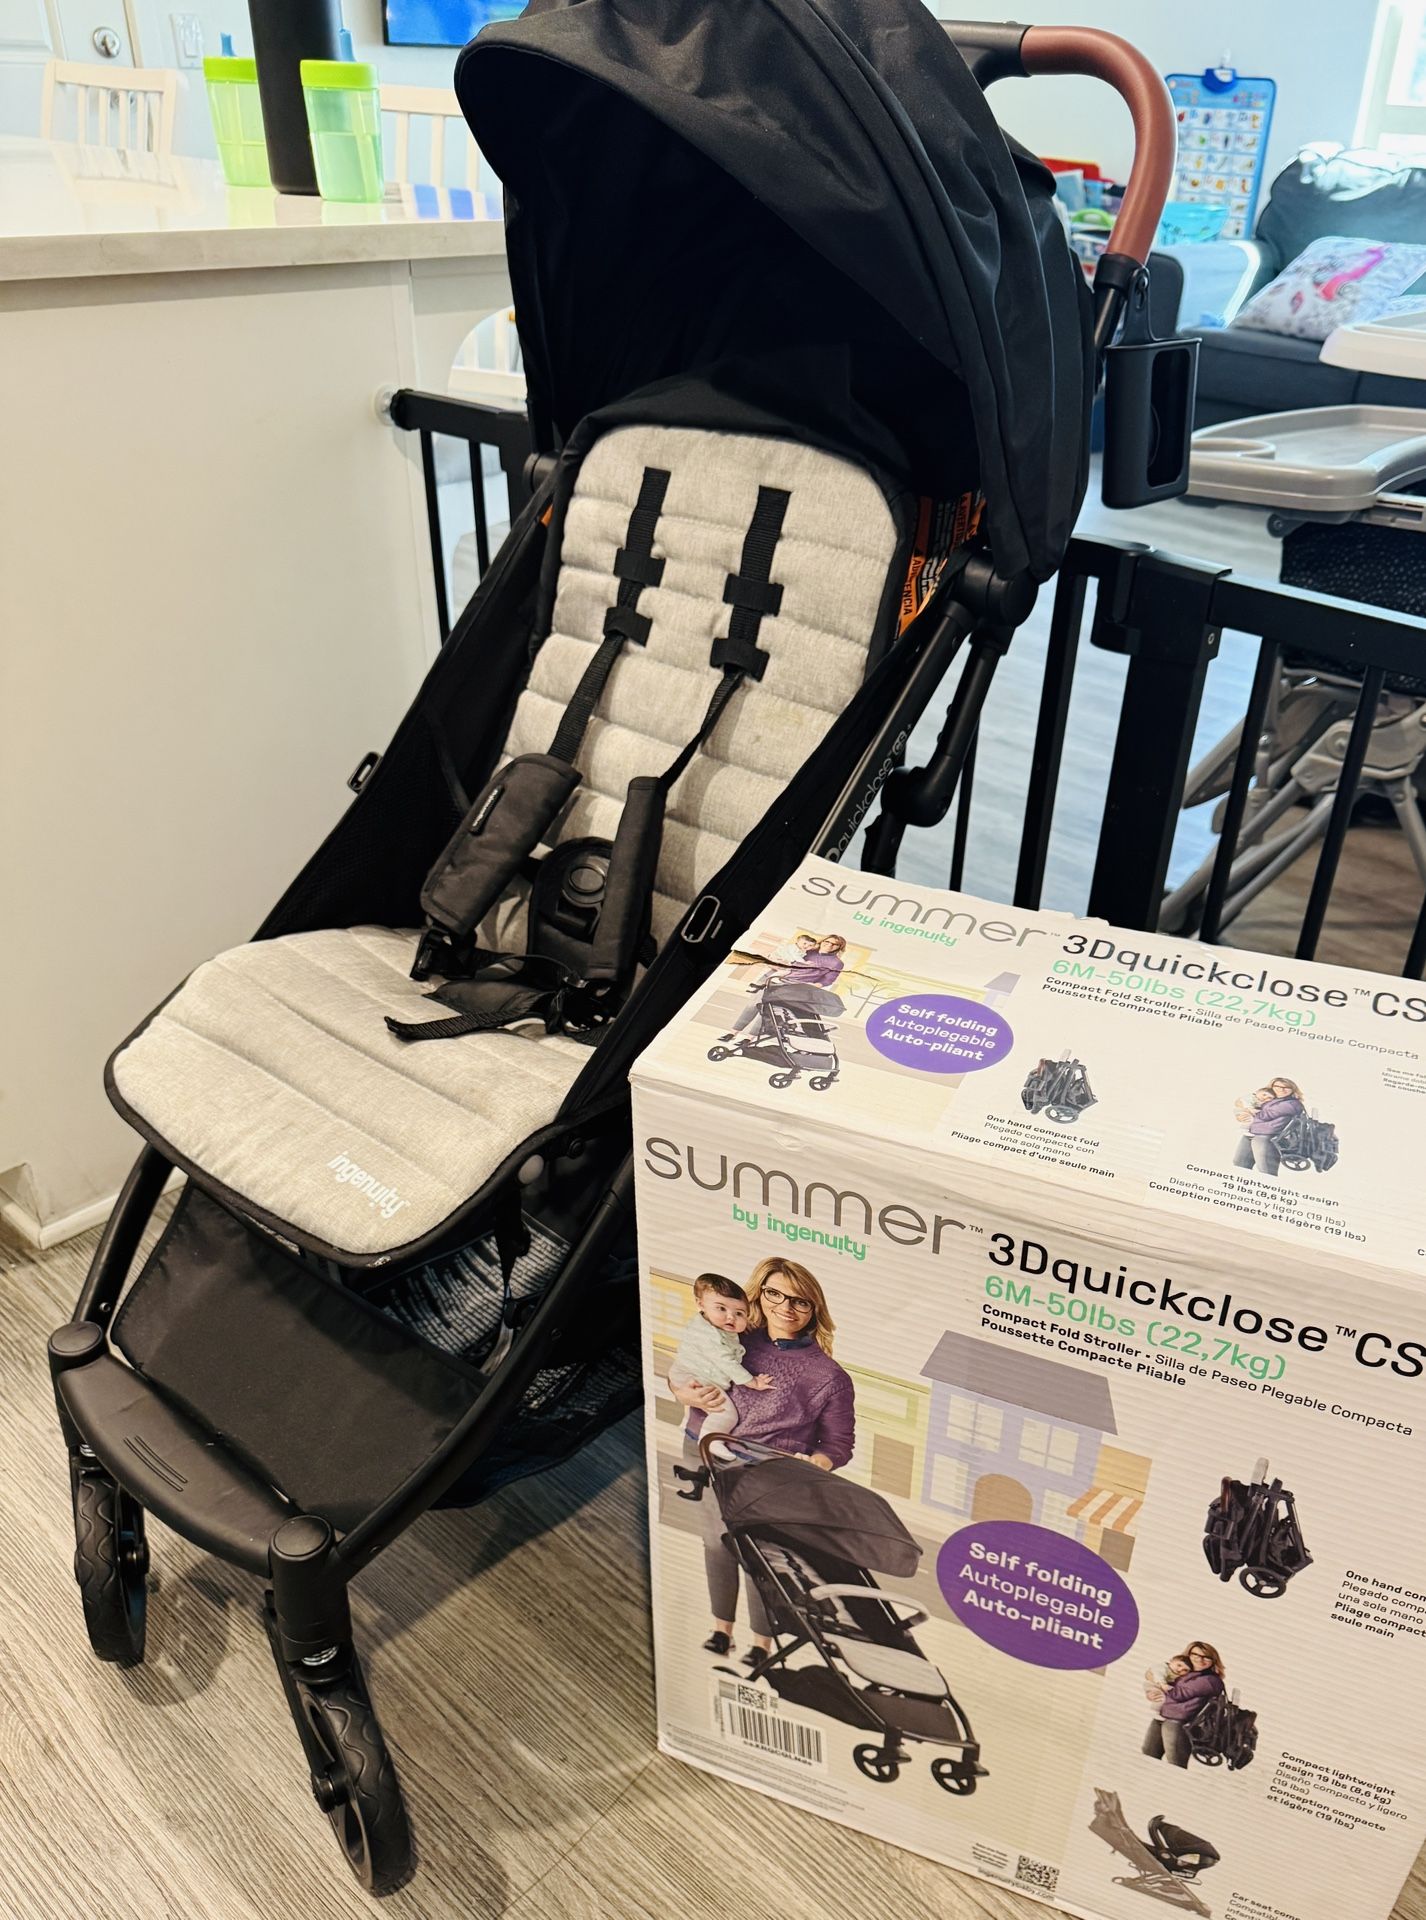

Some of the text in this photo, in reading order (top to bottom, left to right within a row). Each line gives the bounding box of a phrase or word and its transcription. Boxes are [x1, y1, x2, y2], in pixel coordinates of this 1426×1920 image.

[852, 911, 958, 947] by ingenuity
[1042, 983, 1223, 1028] Poussette Compacte Pliable
[1052, 959, 1317, 1027] 6M-50lbs (22,7kg)
[884, 1015, 996, 1049] Autoplegable
[898, 1004, 998, 1037] Self folding
[1045, 976, 1419, 1060] Compact Fold Stroller Silla de Paseo Plegable Compacta
[881, 1029, 984, 1061] Auto-pliant
[984, 1121, 1095, 1155] Plegado compacto con
[986, 1113, 1100, 1147] One hand compact fold
[1000, 1135, 1071, 1157] una sola mano
[951, 1130, 1115, 1179] Pliage compact d'une seule main
[326, 1150, 405, 1219] ingenuity
[1168, 1176, 1205, 1192] Diseño
[1272, 1203, 1304, 1217] ligero
[1306, 1211, 1323, 1222] (19
[1325, 1216, 1347, 1228] lbs)
[1186, 1163, 1340, 1207] Compact lightweight design
[1221, 1181, 1298, 1206] 19 lbs (8,6 kg)
[732, 1203, 867, 1261] by ingenuity
[1149, 1181, 1367, 1243] Conception compacte et légère (19 lbs)
[985, 1275, 1287, 1380] 6M-50lbs (22,7kg)
[981, 1317, 1187, 1386] Poussette Compacte Pliable
[982, 1303, 1413, 1436] Compact Fold Stroller Silla de Paseo Plegable Compacta
[959, 1563, 1115, 1629] Autoplegable
[968, 1541, 1113, 1607] Self folding
[1345, 1570, 1369, 1584] One
[1371, 1578, 1403, 1594] hand
[963, 1589, 1104, 1650] Auto-pliant
[1334, 1601, 1426, 1638] Pliage compact
[1338, 1592, 1424, 1625] una sola mano
[1341, 1580, 1426, 1615] Plegado comp
[1330, 1613, 1395, 1638] seule main
[1272, 1777, 1310, 1796] (19 lbs)
[1275, 1768, 1408, 1821] Diseño compacto y ligero
[1278, 1761, 1392, 1805] design 19 lbs (8,6 kg)
[1281, 1751, 1396, 1797] Compact lightweight
[1266, 1794, 1355, 1831] et légère (19 lbs)
[1269, 1785, 1386, 1832] Conception compacte
[1231, 1892, 1250, 1902] Car
[1250, 1900, 1273, 1912] seat
